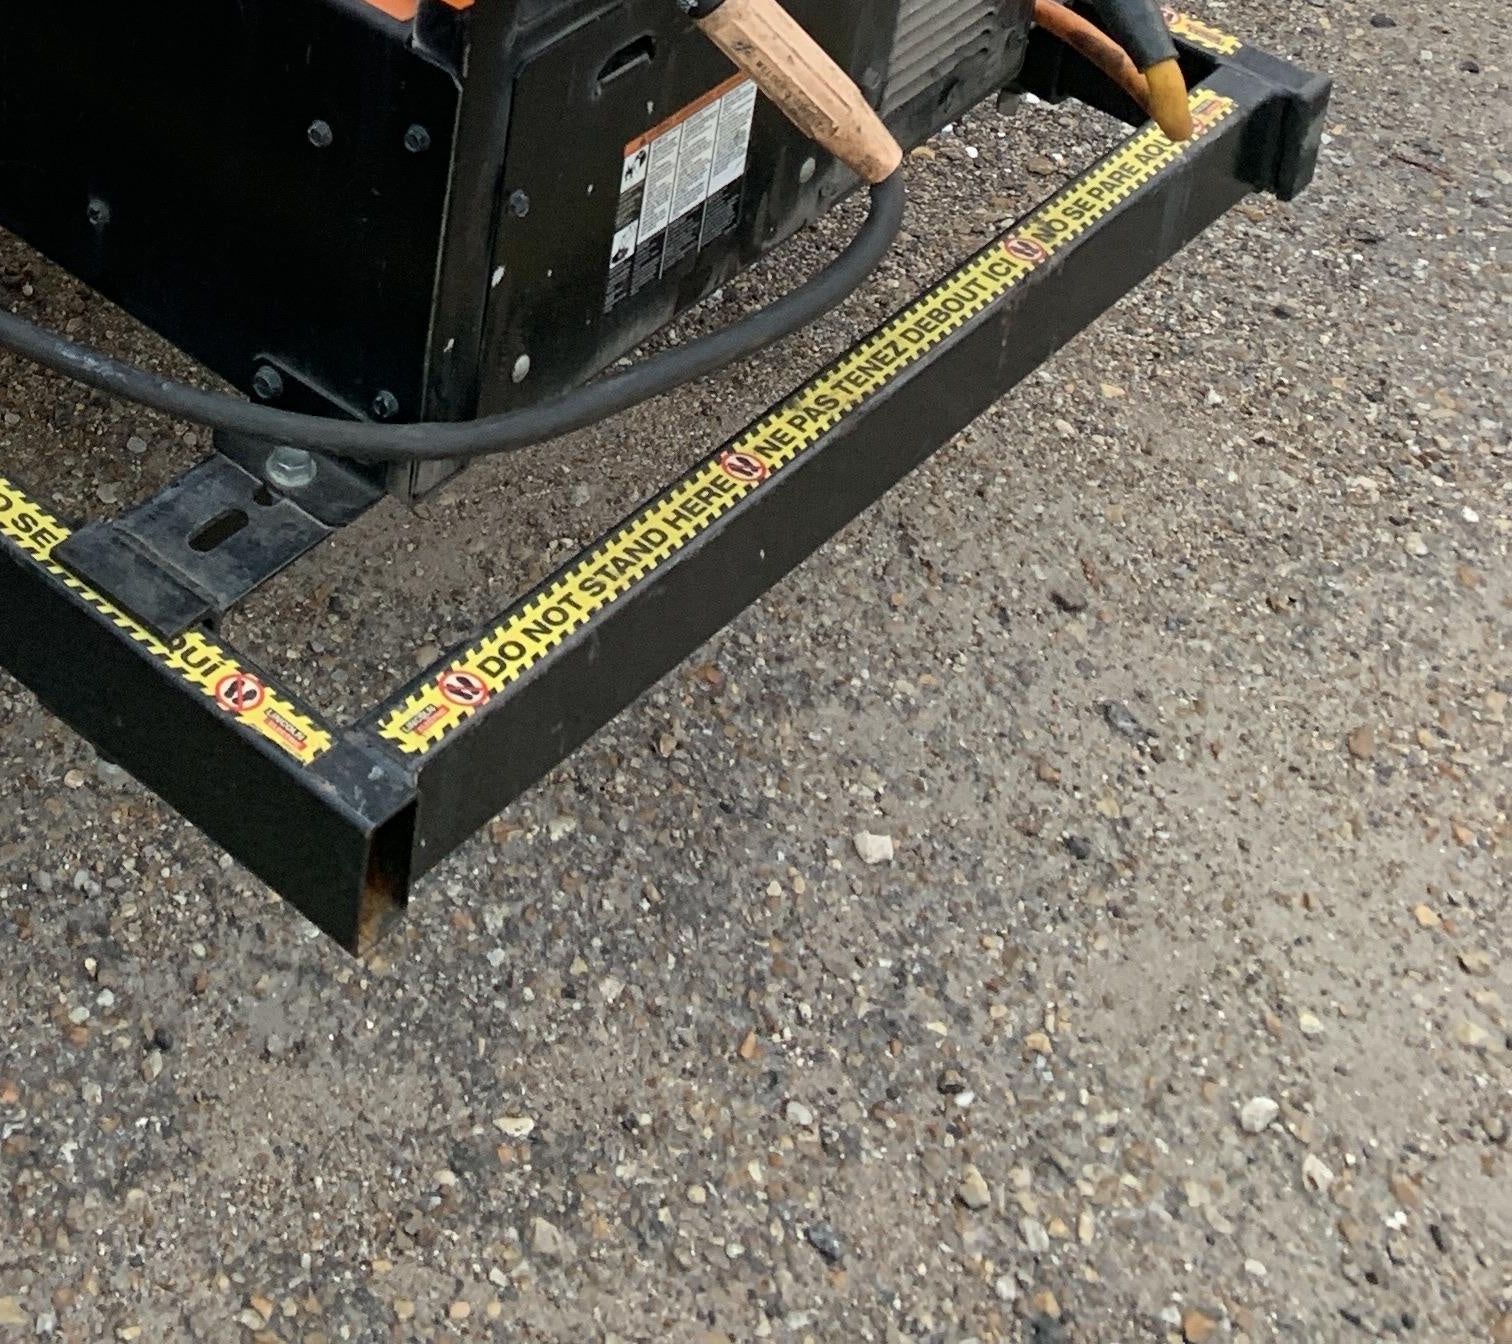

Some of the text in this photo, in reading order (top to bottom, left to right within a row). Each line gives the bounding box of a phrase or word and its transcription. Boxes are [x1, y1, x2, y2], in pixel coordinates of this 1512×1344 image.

[1031, 138, 1175, 244] NO SE PARE AQU
[753, 257, 1020, 460] NE PAS TENEZ DEBOUT ICI
[11, 512, 59, 549] SE
[477, 473, 738, 680] DO NOT STAND HERE
